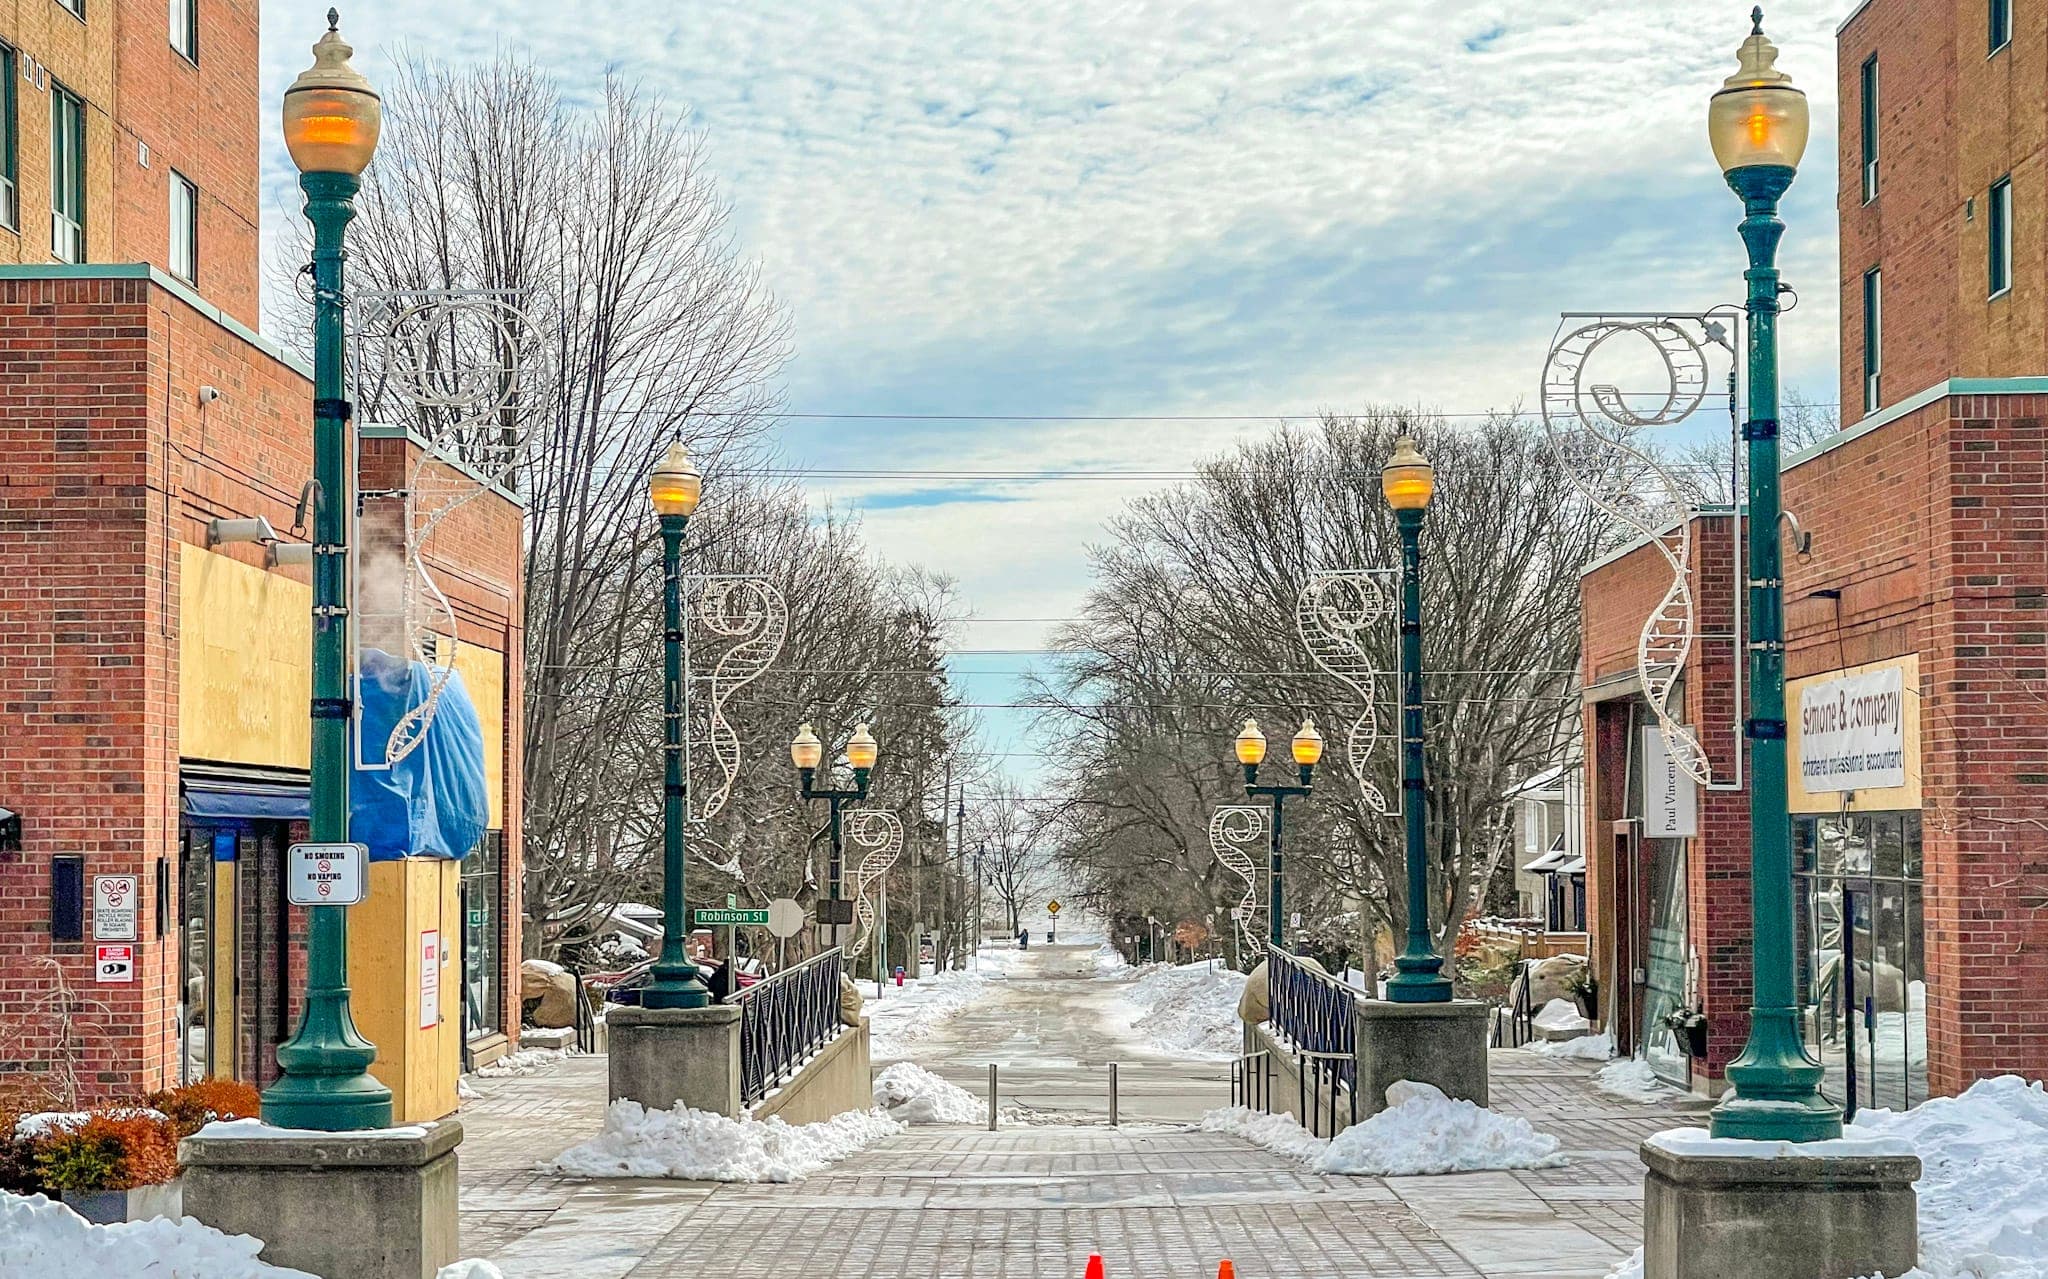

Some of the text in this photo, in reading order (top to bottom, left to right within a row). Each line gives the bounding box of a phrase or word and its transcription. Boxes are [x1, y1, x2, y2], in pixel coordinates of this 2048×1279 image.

[1803, 689, 1901, 736] simone & company
[1866, 747, 1902, 771] accountant
[1664, 760, 1676, 805] Vincent
[1664, 808, 1676, 831] Paul
[304, 852, 345, 860] NO SMOKING
[700, 911, 764, 922] Robinson St
